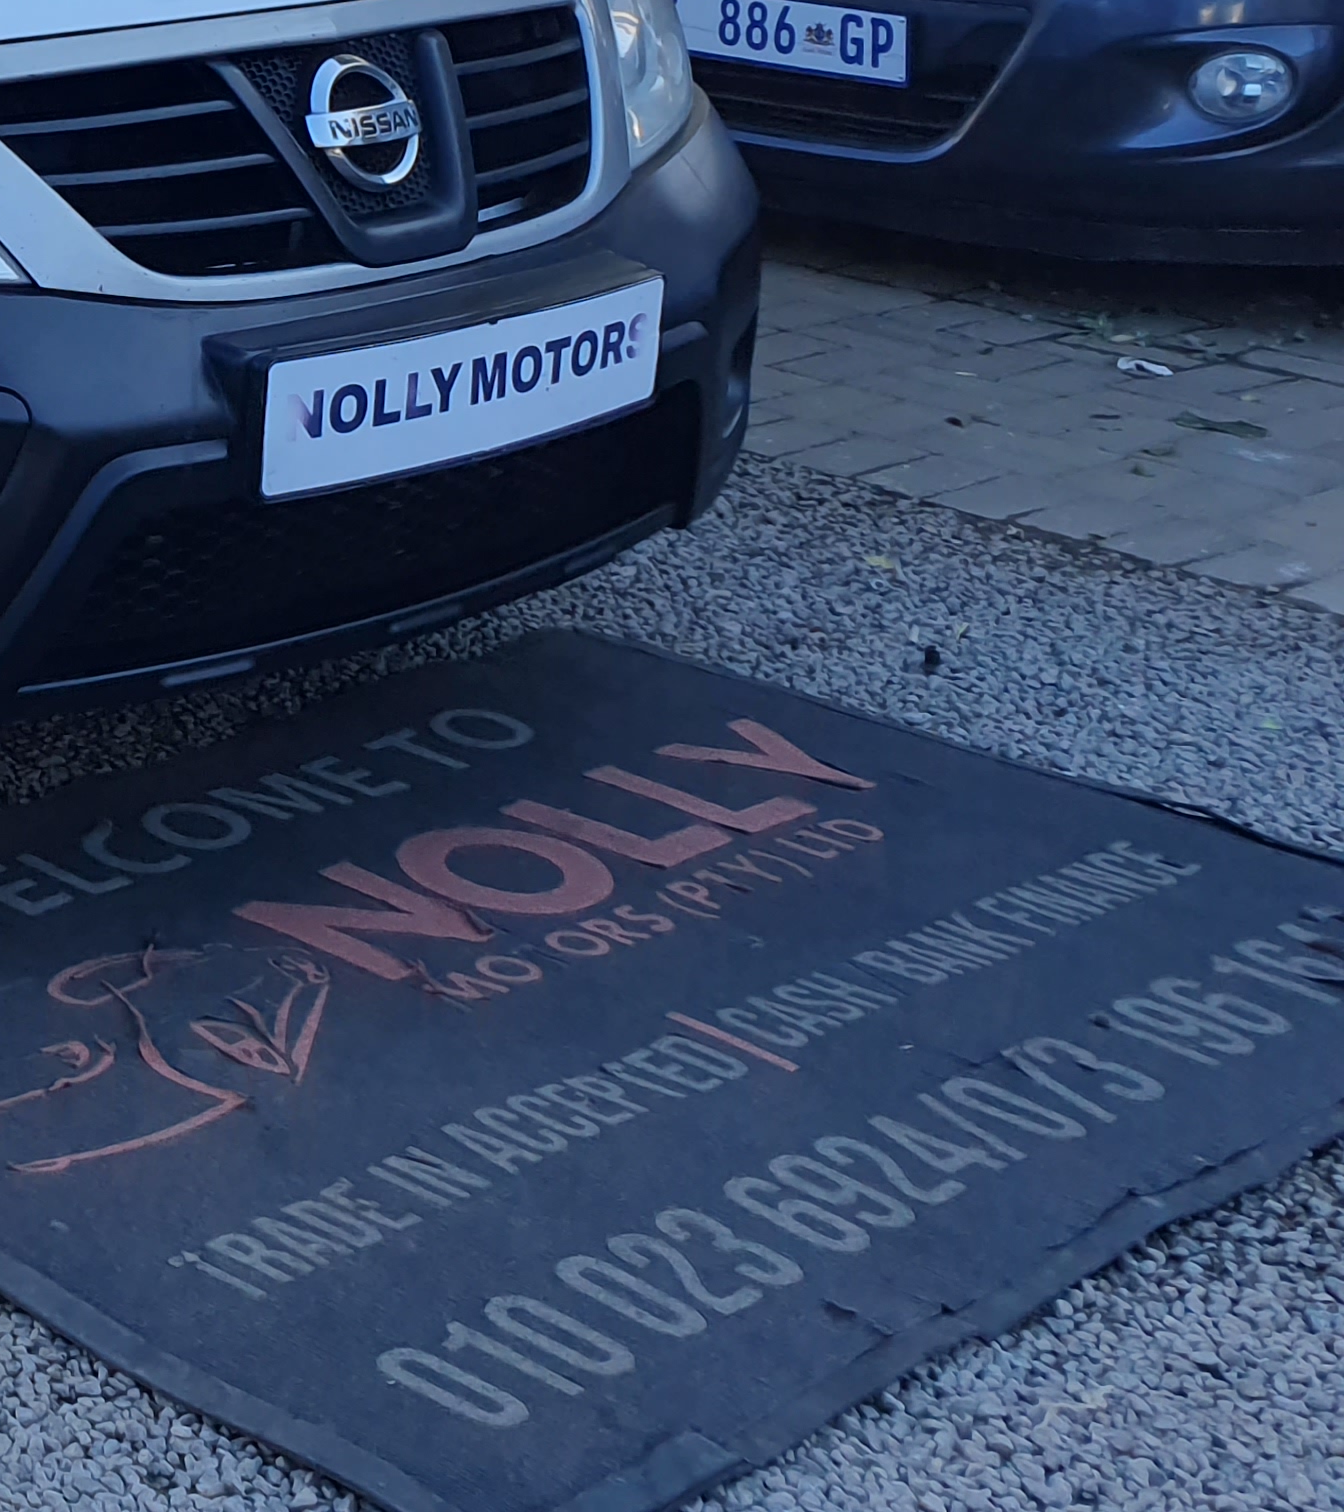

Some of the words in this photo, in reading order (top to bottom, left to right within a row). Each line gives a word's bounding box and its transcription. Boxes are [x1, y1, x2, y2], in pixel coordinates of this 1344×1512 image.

[839, 13, 894, 68] GP
[328, 108, 418, 140] NISSAN
[288, 362, 463, 441] NOLLY
[470, 312, 647, 406] MOTORS
[363, 707, 536, 769] TO
[231, 717, 877, 981] NOLLY
[167, 1175, 423, 1299] TRADE
[366, 1146, 492, 1208] IN
[441, 1034, 750, 1174] ACCEPTED
[979, 840, 1201, 935] FINANCE
[375, 1295, 636, 1428] 010
[555, 1207, 804, 1338] 023
[1088, 977, 1292, 1065] 196
